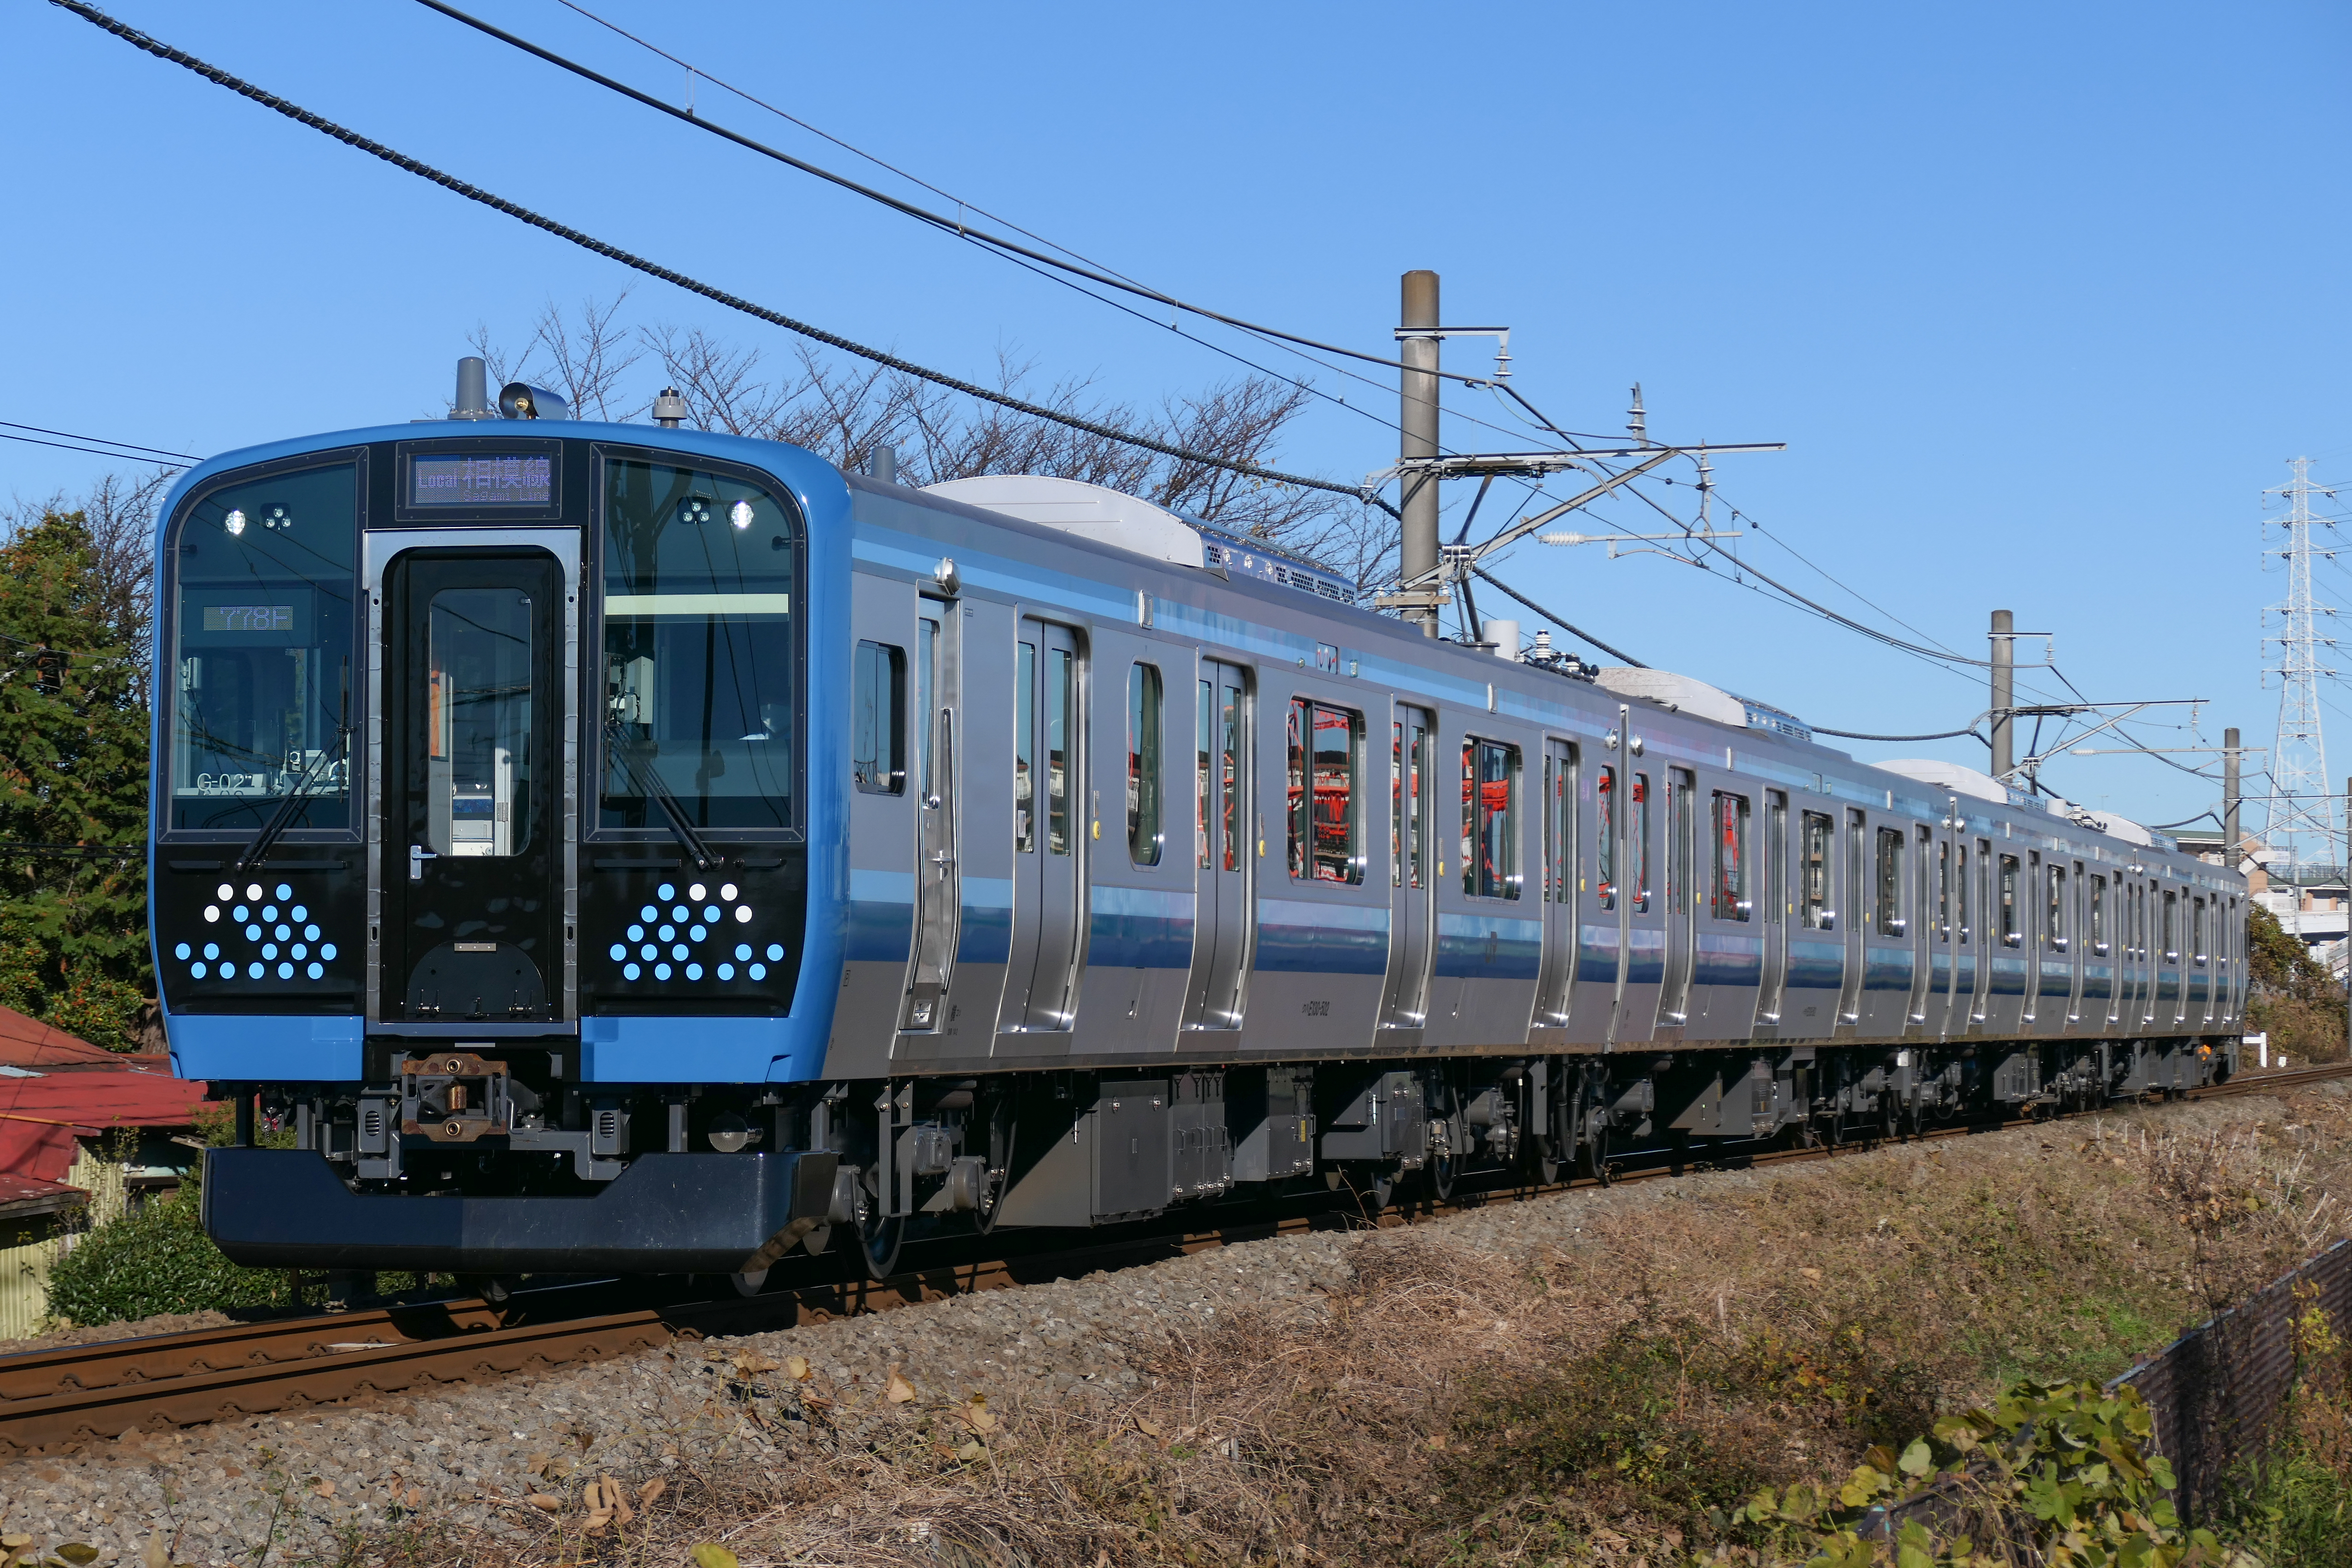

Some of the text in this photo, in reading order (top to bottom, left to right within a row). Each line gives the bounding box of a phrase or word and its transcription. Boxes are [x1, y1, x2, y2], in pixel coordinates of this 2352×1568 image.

[418, 469, 458, 488] Local
[462, 457, 550, 489] 相模線
[221, 606, 290, 630] 778F
[197, 773, 244, 791] G-02
